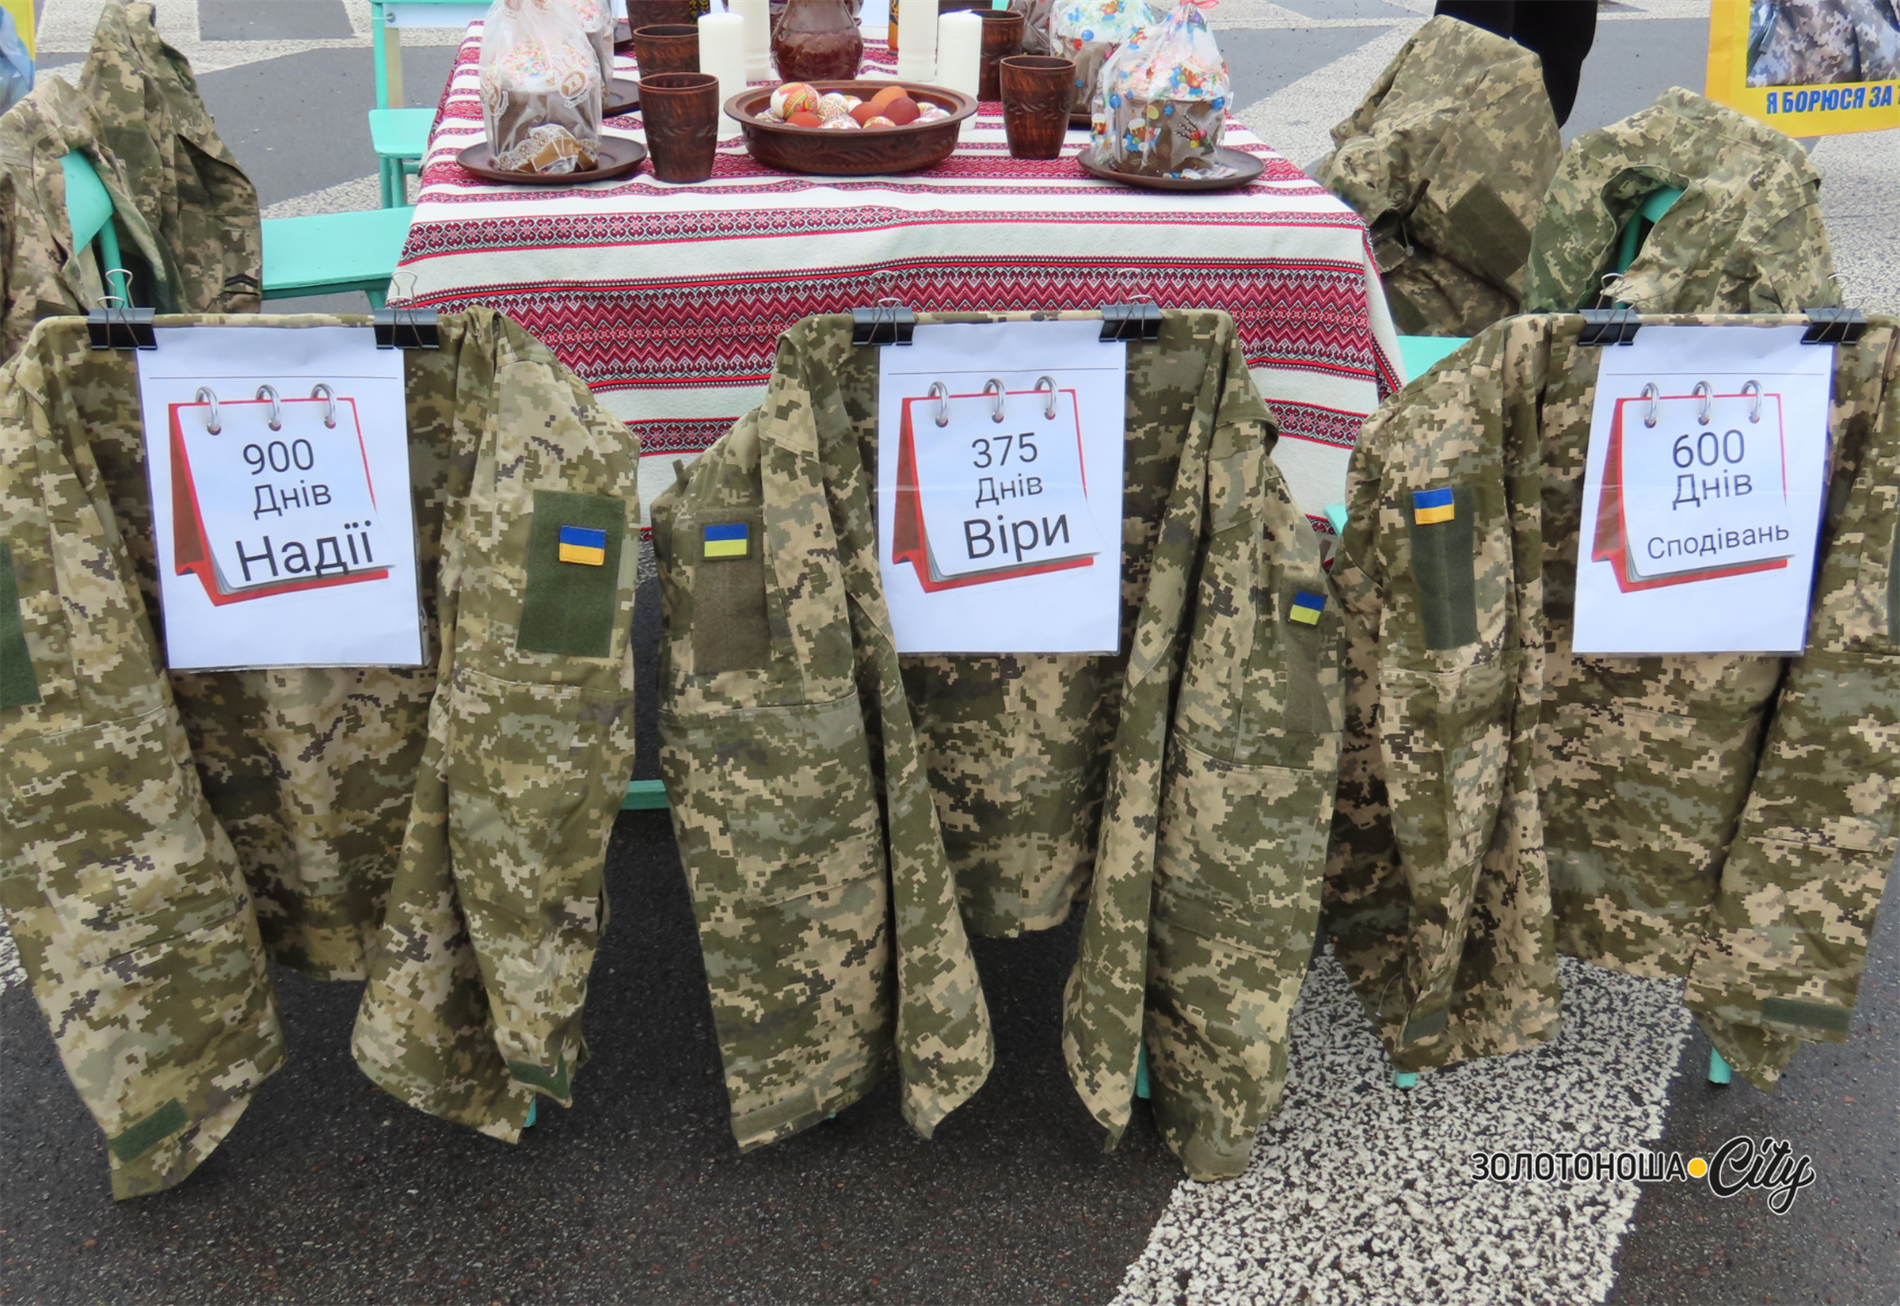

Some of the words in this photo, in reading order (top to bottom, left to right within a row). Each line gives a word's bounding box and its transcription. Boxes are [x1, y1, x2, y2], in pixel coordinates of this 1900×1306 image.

[1766, 92, 1778, 114] Я
[1782, 87, 1866, 113] БОРЮСЯ
[1869, 85, 1892, 108] ЗА
[243, 438, 315, 475] 900
[971, 432, 1038, 469] 375
[1672, 429, 1745, 468] 600
[254, 479, 332, 520] Днів
[974, 473, 1043, 508] Днів
[1672, 468, 1753, 511] Днів
[235, 519, 374, 582] Надії
[963, 513, 1071, 563] Віри
[1647, 523, 1790, 560] Сподівань
